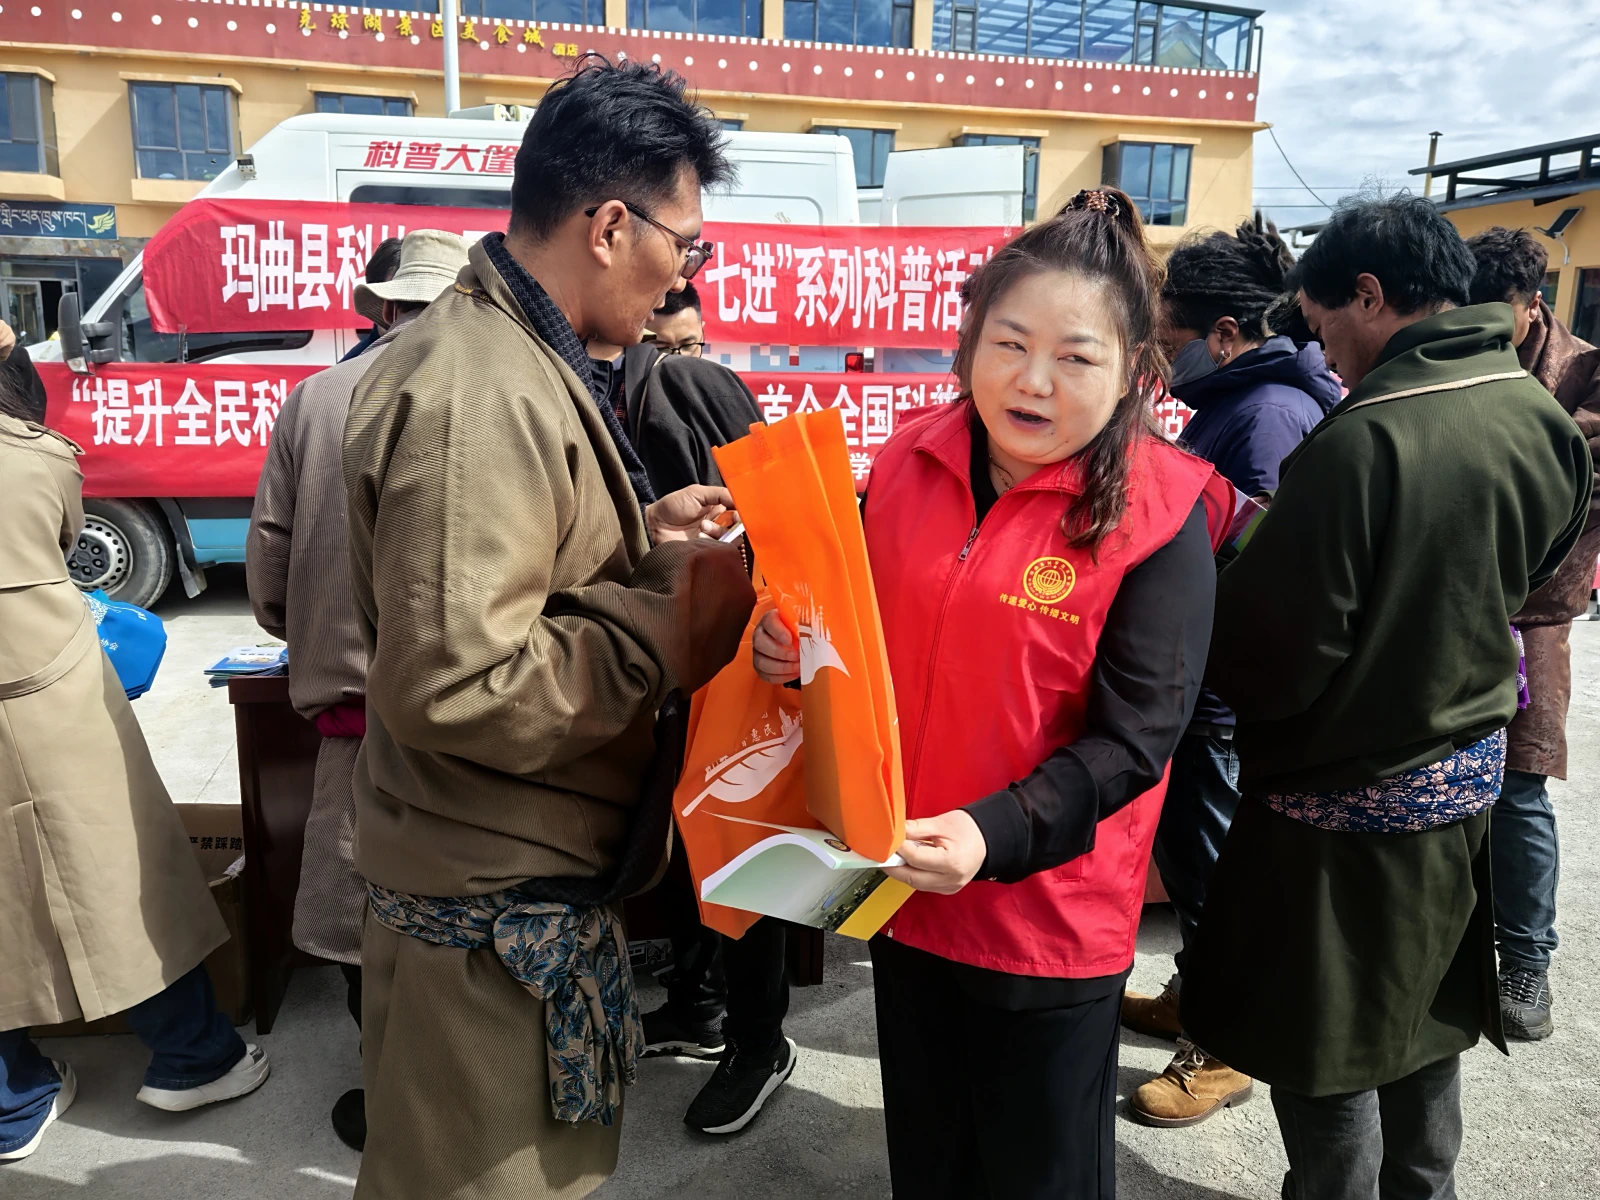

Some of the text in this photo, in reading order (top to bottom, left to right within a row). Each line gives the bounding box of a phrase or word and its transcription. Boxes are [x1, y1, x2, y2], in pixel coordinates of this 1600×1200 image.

[554, 42, 579, 57] 酒店
[363, 140, 519, 174] 科普大篷
[220, 220, 405, 313] 玛曲县科
[1039, 604, 1080, 625] 传播文明
